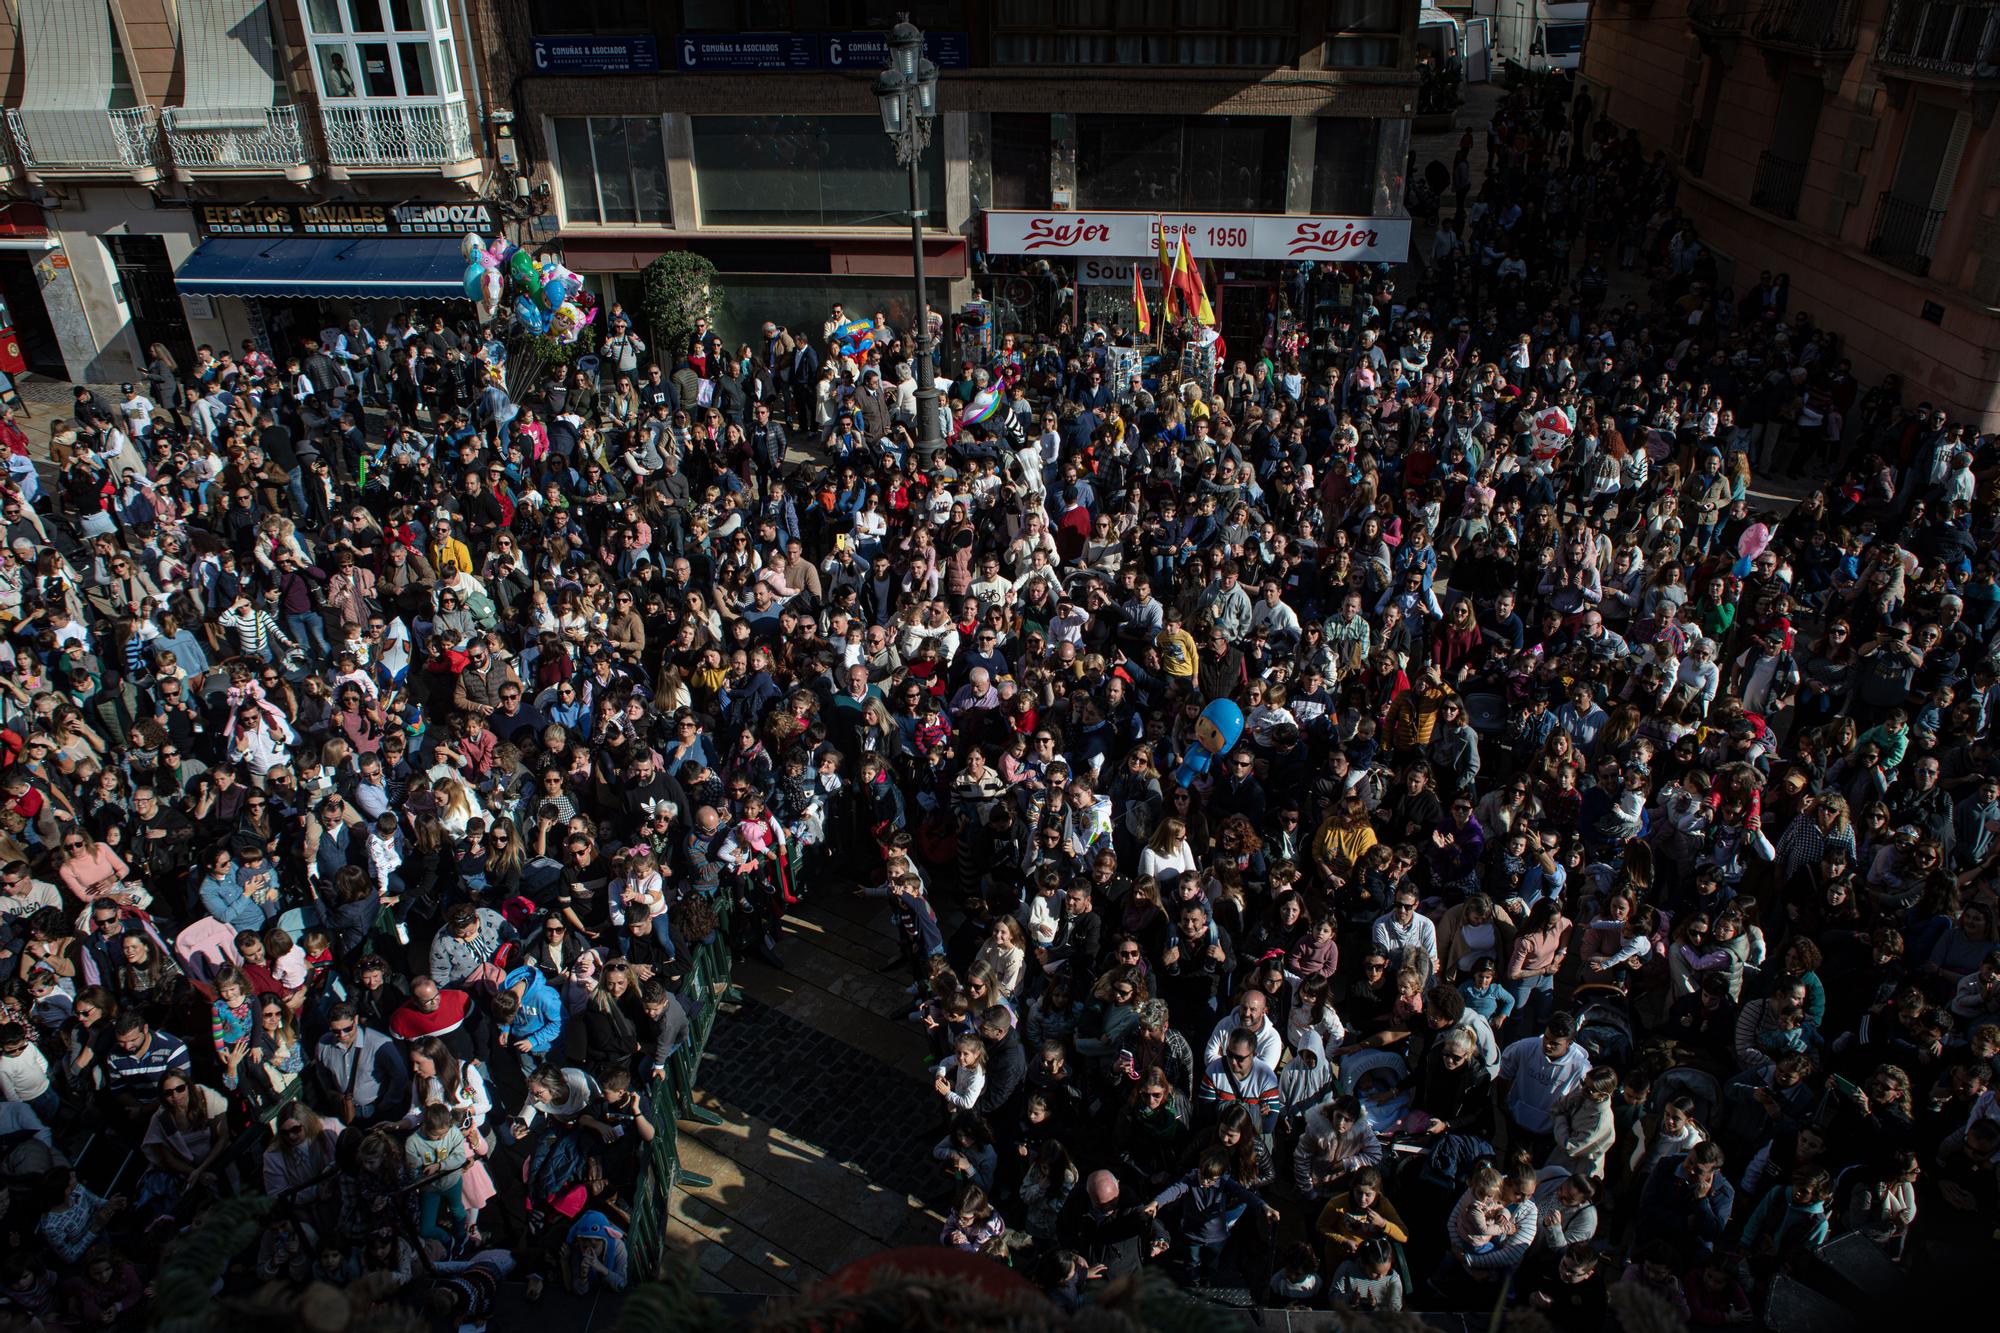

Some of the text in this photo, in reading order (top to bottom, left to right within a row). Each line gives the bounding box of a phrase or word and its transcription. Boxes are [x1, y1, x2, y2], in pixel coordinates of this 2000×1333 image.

[552, 45, 627, 55] COMUÑAS & ASOCIADOS
[701, 42, 779, 52] COMUÑAS & ASOCIADOS
[848, 41, 880, 51] COMUÑAS
[203, 206, 491, 223] EFECTOS NAVALES MENDOZA
[1021, 217, 1110, 251] Sajor
[1151, 222, 1197, 234] Desde
[1208, 227, 1247, 247] 1950
[1287, 222, 1378, 256] Sajor
